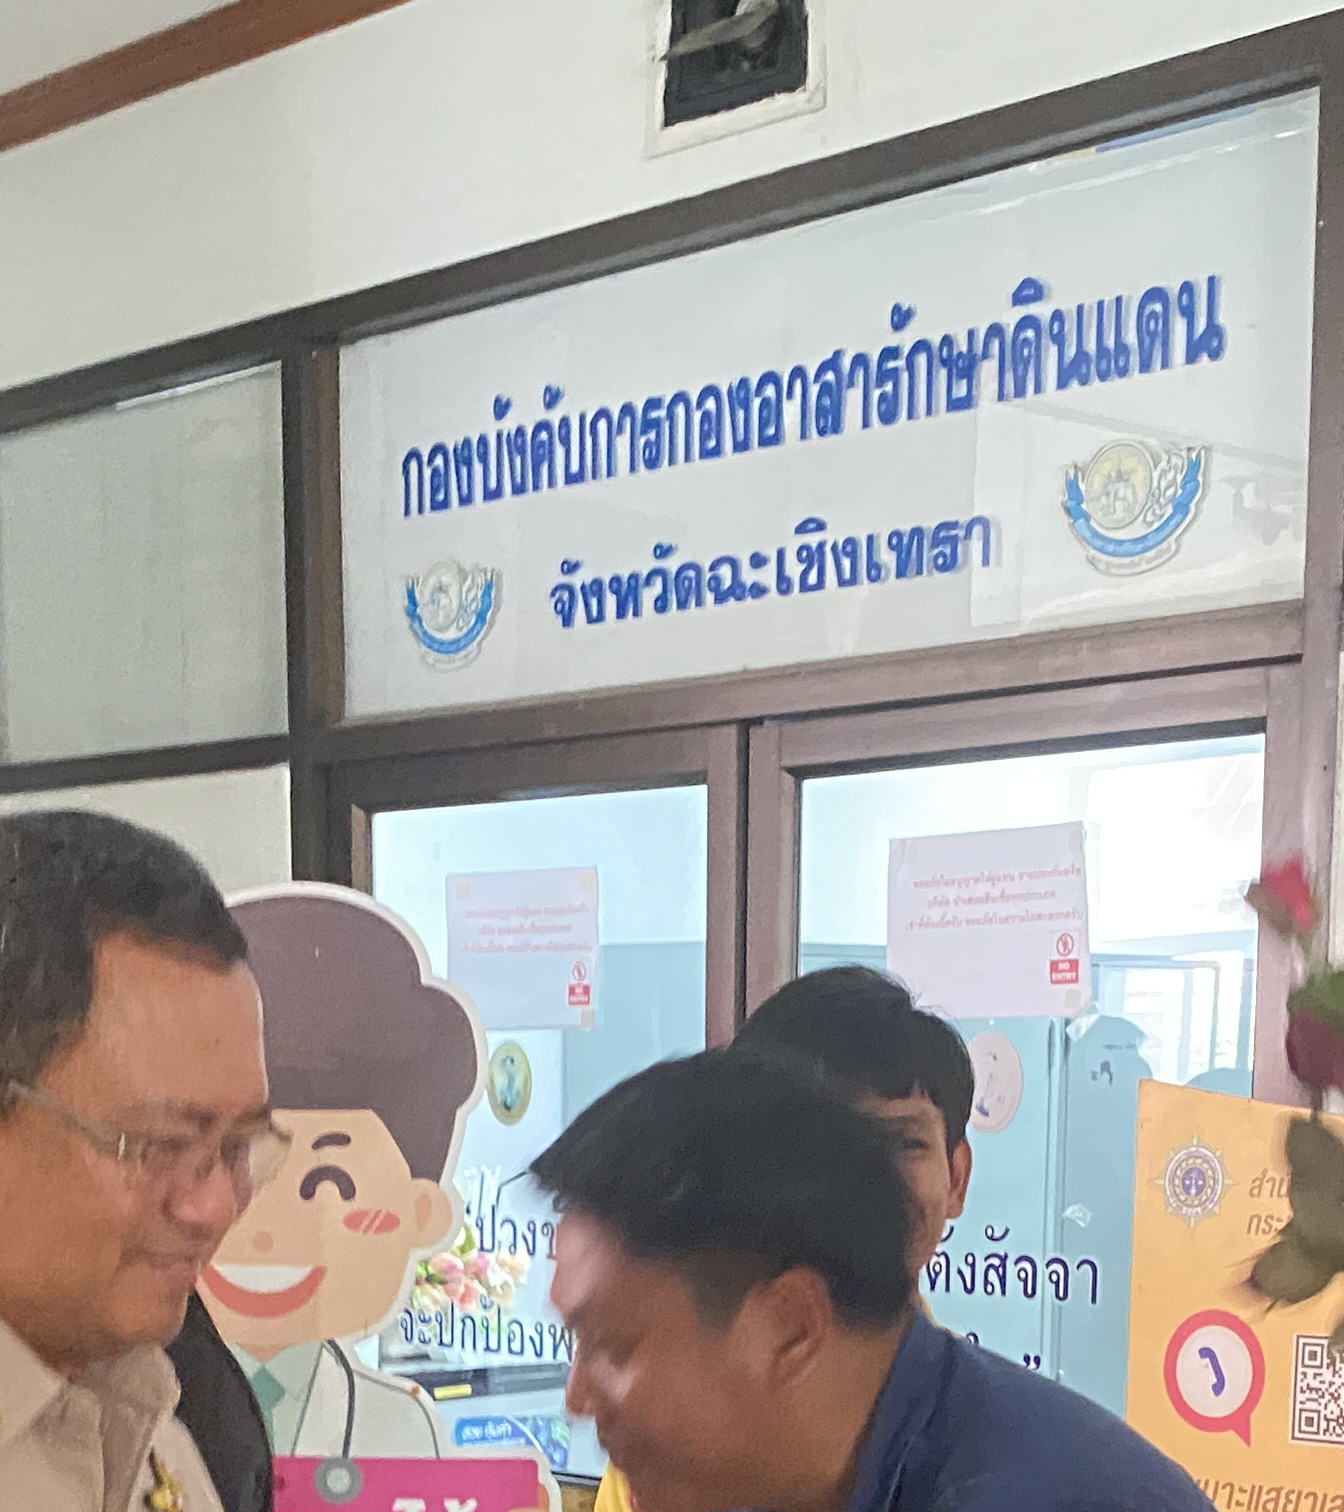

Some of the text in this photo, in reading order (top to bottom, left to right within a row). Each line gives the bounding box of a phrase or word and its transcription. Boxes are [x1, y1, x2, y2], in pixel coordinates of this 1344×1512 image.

[401, 273, 1226, 518] กองบังคับการกองอาสารักษาดินแดน
[549, 512, 994, 629] จังหวัดฉะเชิงเทรา
